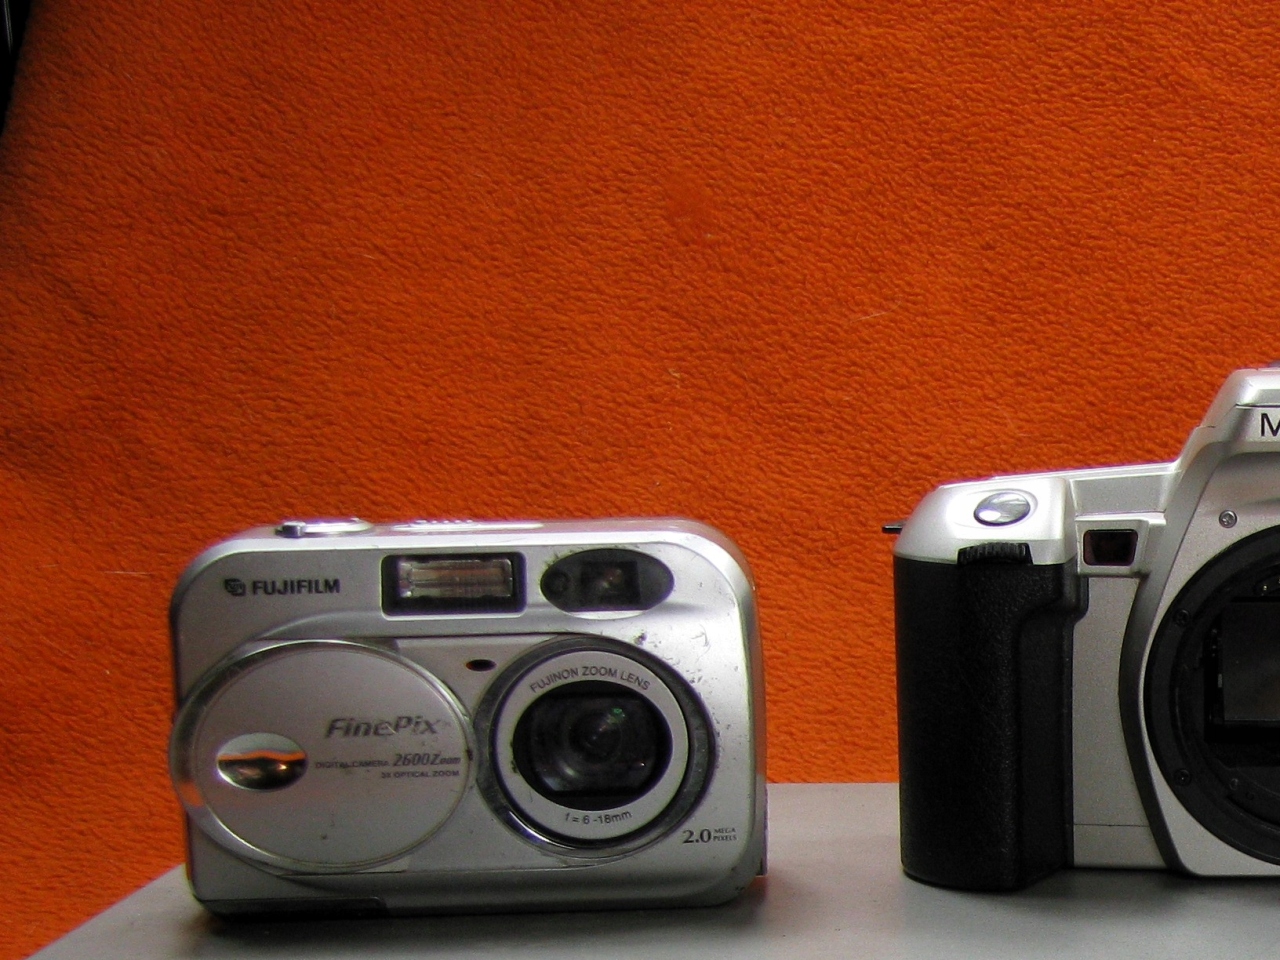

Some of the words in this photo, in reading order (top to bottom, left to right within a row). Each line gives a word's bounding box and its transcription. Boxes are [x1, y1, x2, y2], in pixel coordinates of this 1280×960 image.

[252, 578, 341, 595] FUJIFILM
[530, 667, 579, 693] FUJINON
[582, 666, 618, 678] ZOOM
[620, 671, 651, 691] LENS
[326, 715, 441, 738] FinePix
[394, 771, 429, 779] OPTICAL
[433, 769, 460, 777] ZOOM
[682, 828, 711, 844] 2.0
[713, 834, 738, 842] PIXELS
